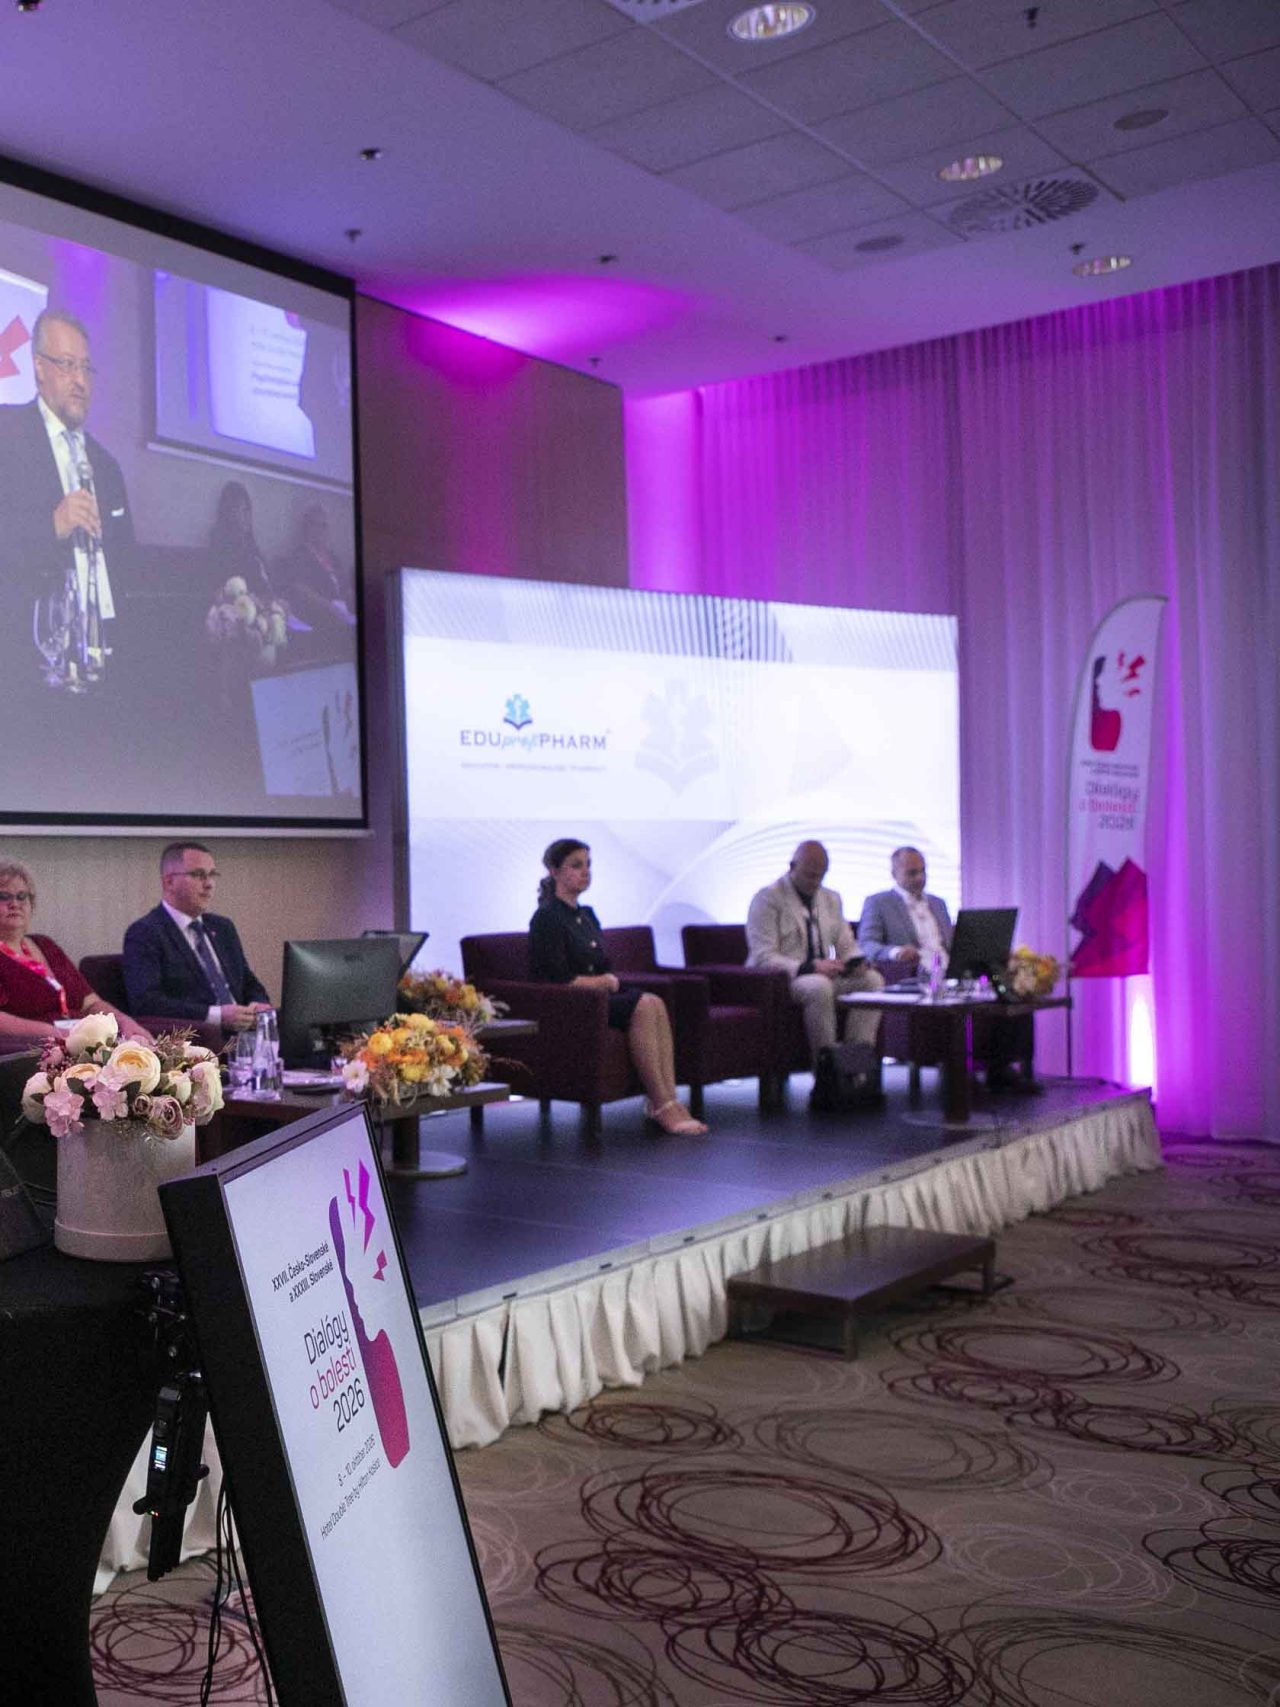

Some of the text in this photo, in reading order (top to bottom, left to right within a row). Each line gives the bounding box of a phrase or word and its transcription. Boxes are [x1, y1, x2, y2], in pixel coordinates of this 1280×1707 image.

[288, 1240, 329, 1279] Česko-Slovenské
[289, 1292, 294, 1303] a
[309, 1258, 334, 1286] Slovenské
[304, 1310, 349, 1365] Dialógy
[310, 1340, 357, 1410] o bolesti
[333, 1377, 365, 1433] 2026
